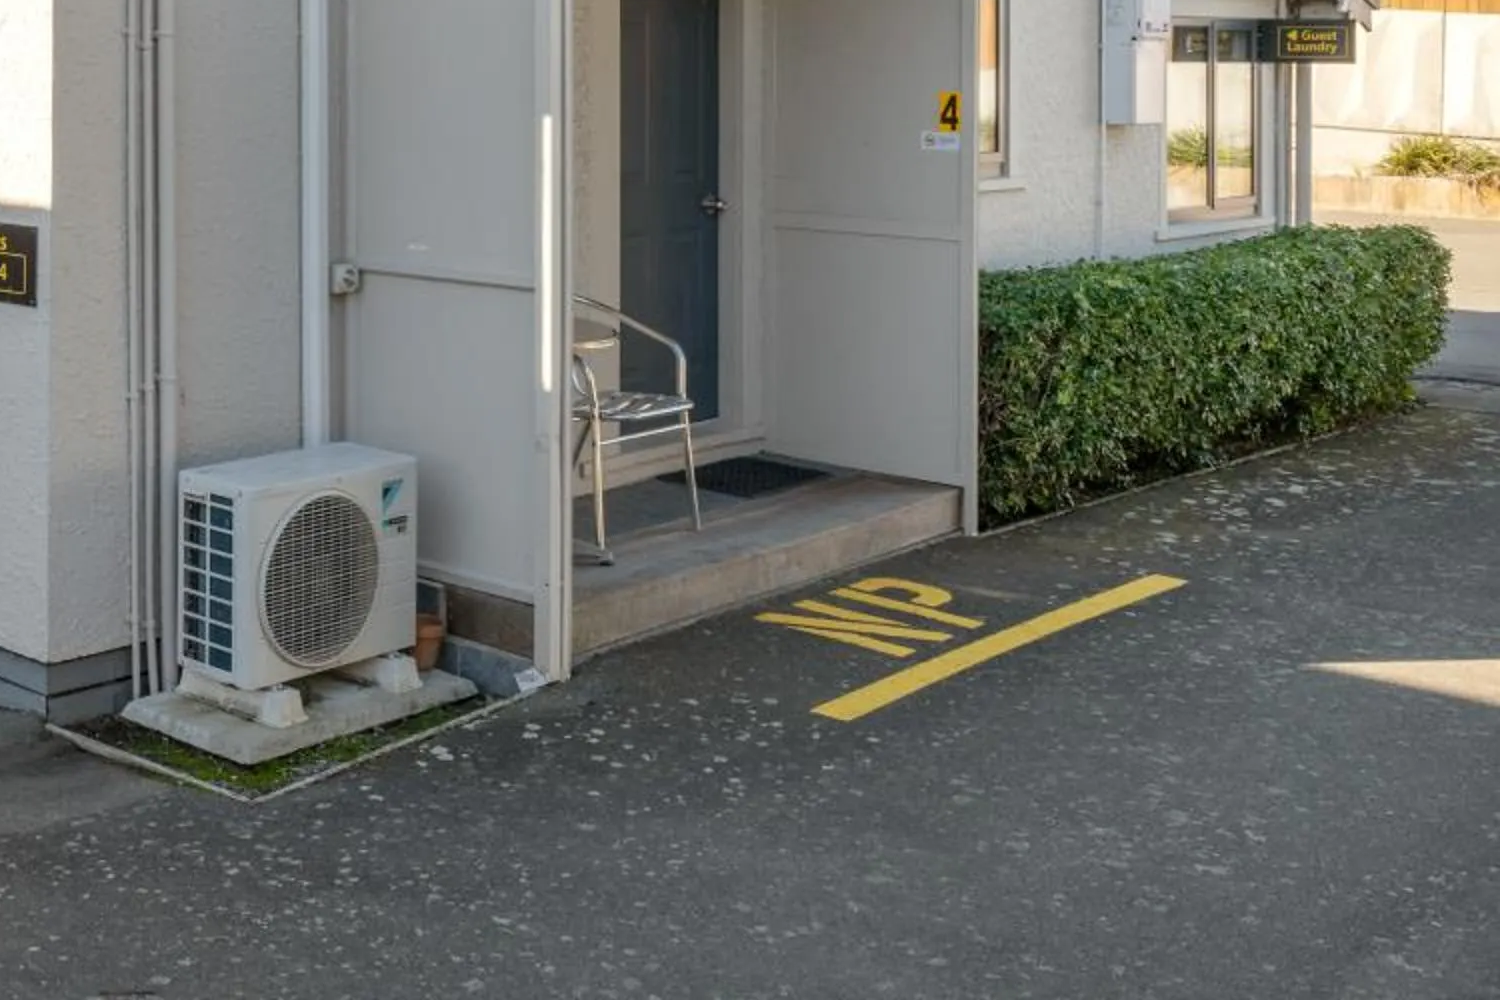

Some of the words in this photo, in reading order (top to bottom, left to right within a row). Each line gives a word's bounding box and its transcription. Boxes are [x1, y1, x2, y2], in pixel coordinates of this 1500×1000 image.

[1301, 29, 1337, 41] Guest
[1287, 42, 1337, 54] Laundry
[940, 93, 959, 131] 4
